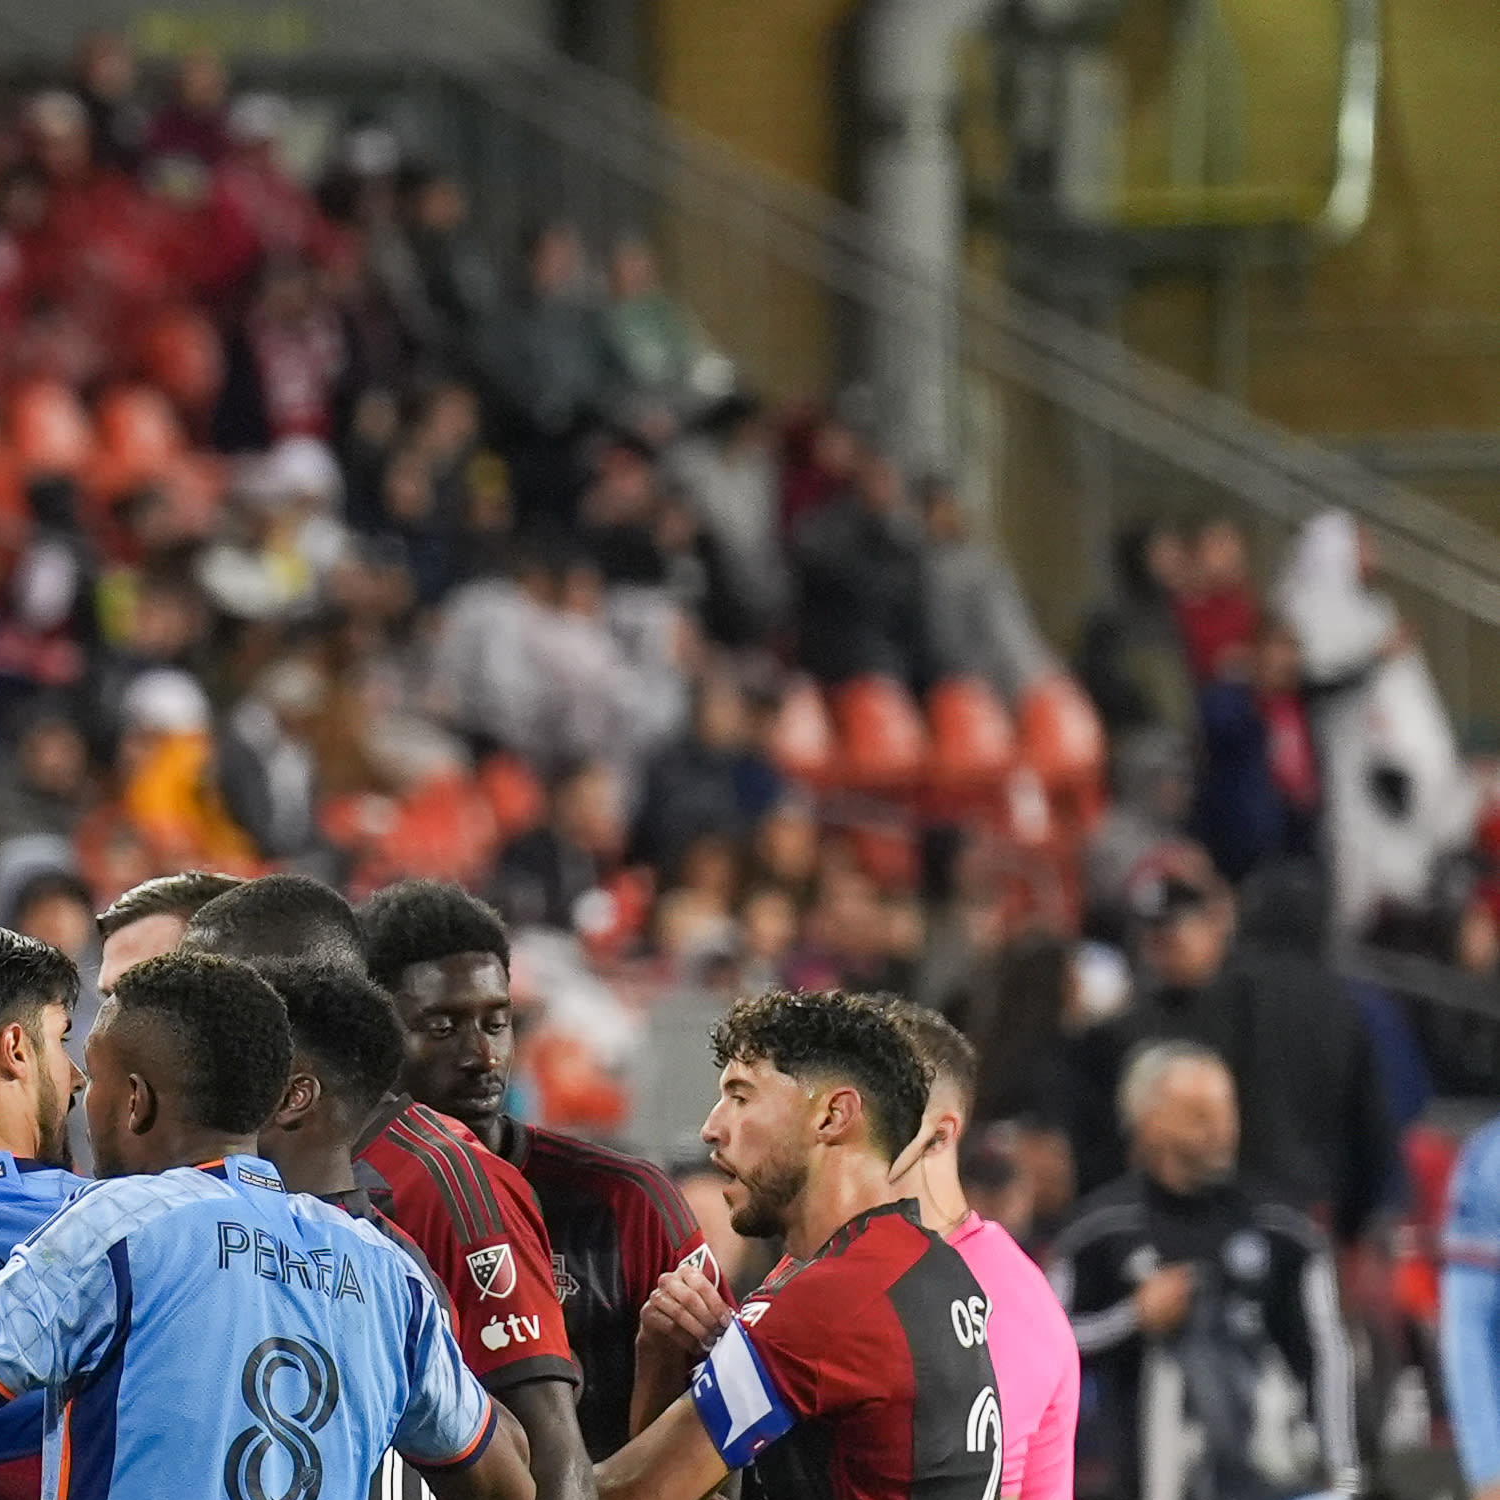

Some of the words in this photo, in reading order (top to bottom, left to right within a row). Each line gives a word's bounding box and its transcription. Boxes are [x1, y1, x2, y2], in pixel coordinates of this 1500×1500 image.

[216, 1221, 366, 1305] PEREA
[471, 1252, 498, 1269] MLS
[506, 1313, 542, 1344] tv
